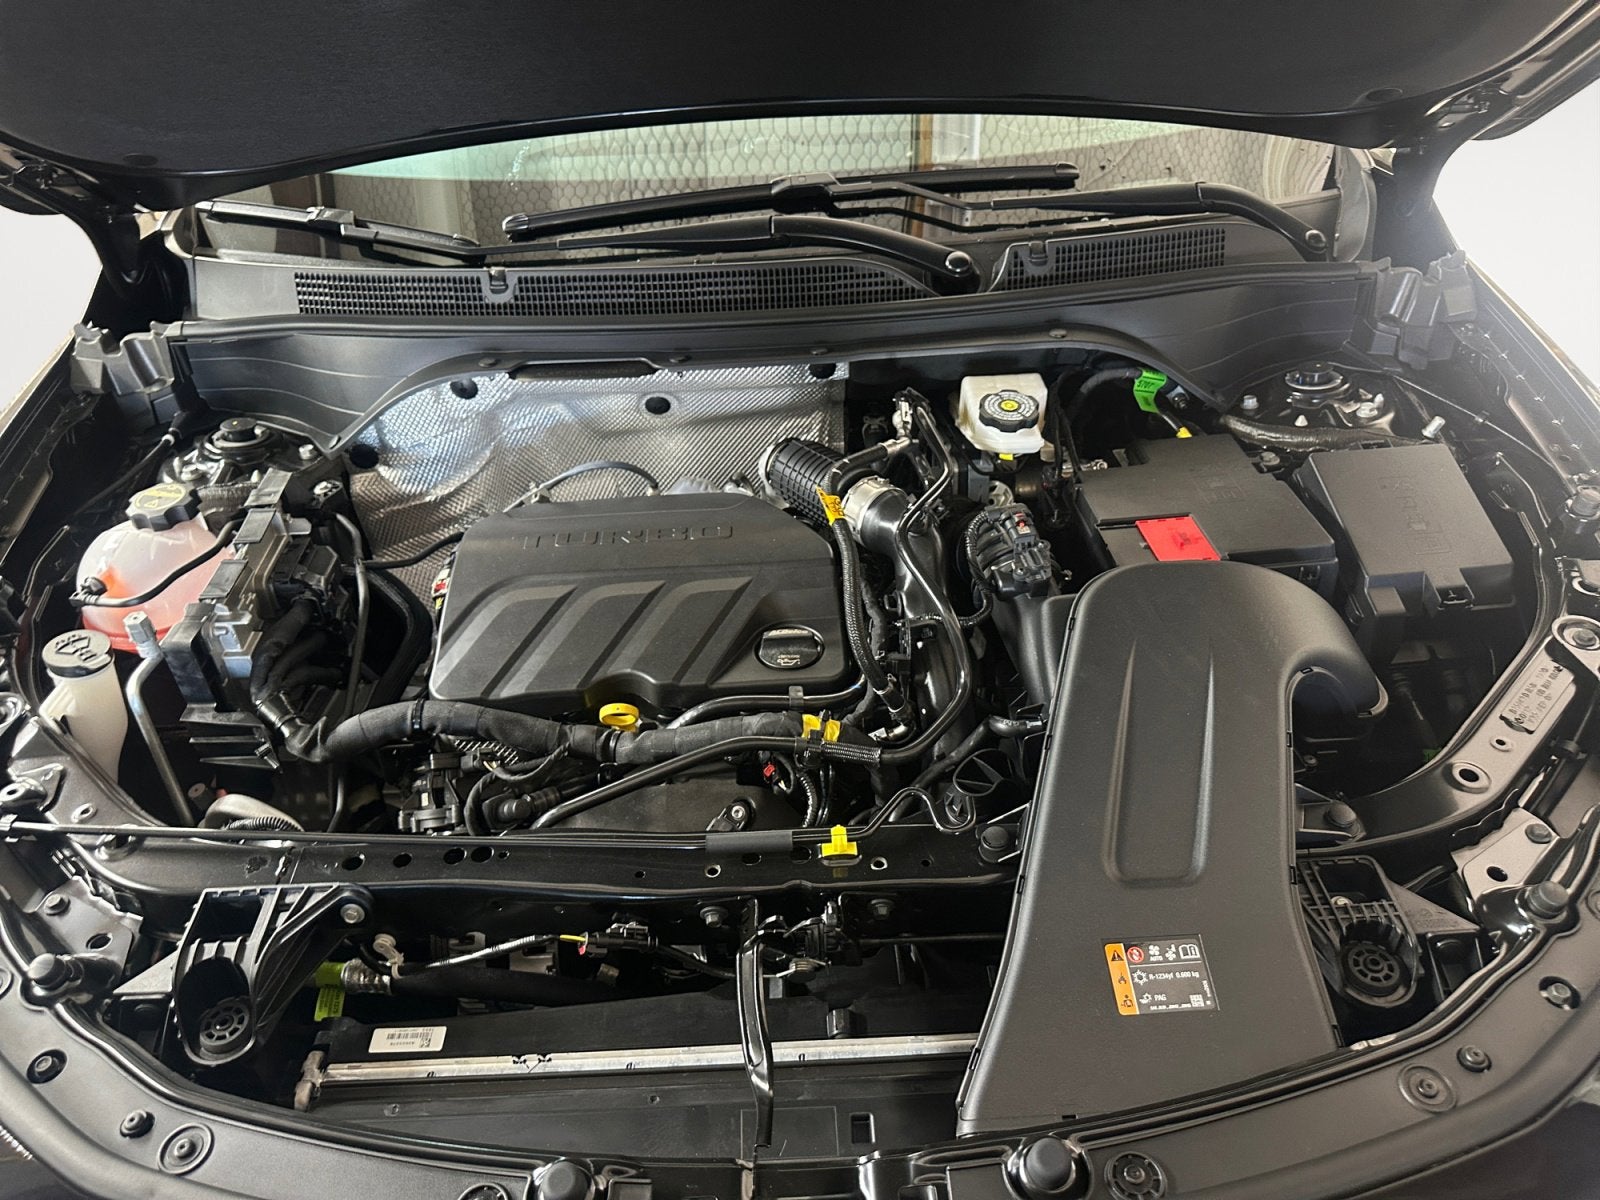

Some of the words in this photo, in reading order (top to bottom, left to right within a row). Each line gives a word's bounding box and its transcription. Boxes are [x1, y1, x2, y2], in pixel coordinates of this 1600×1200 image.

[512, 525, 734, 550] TURBO
[768, 628, 809, 636] ACDelco
[1148, 972, 1173, 980] R-1234yf
